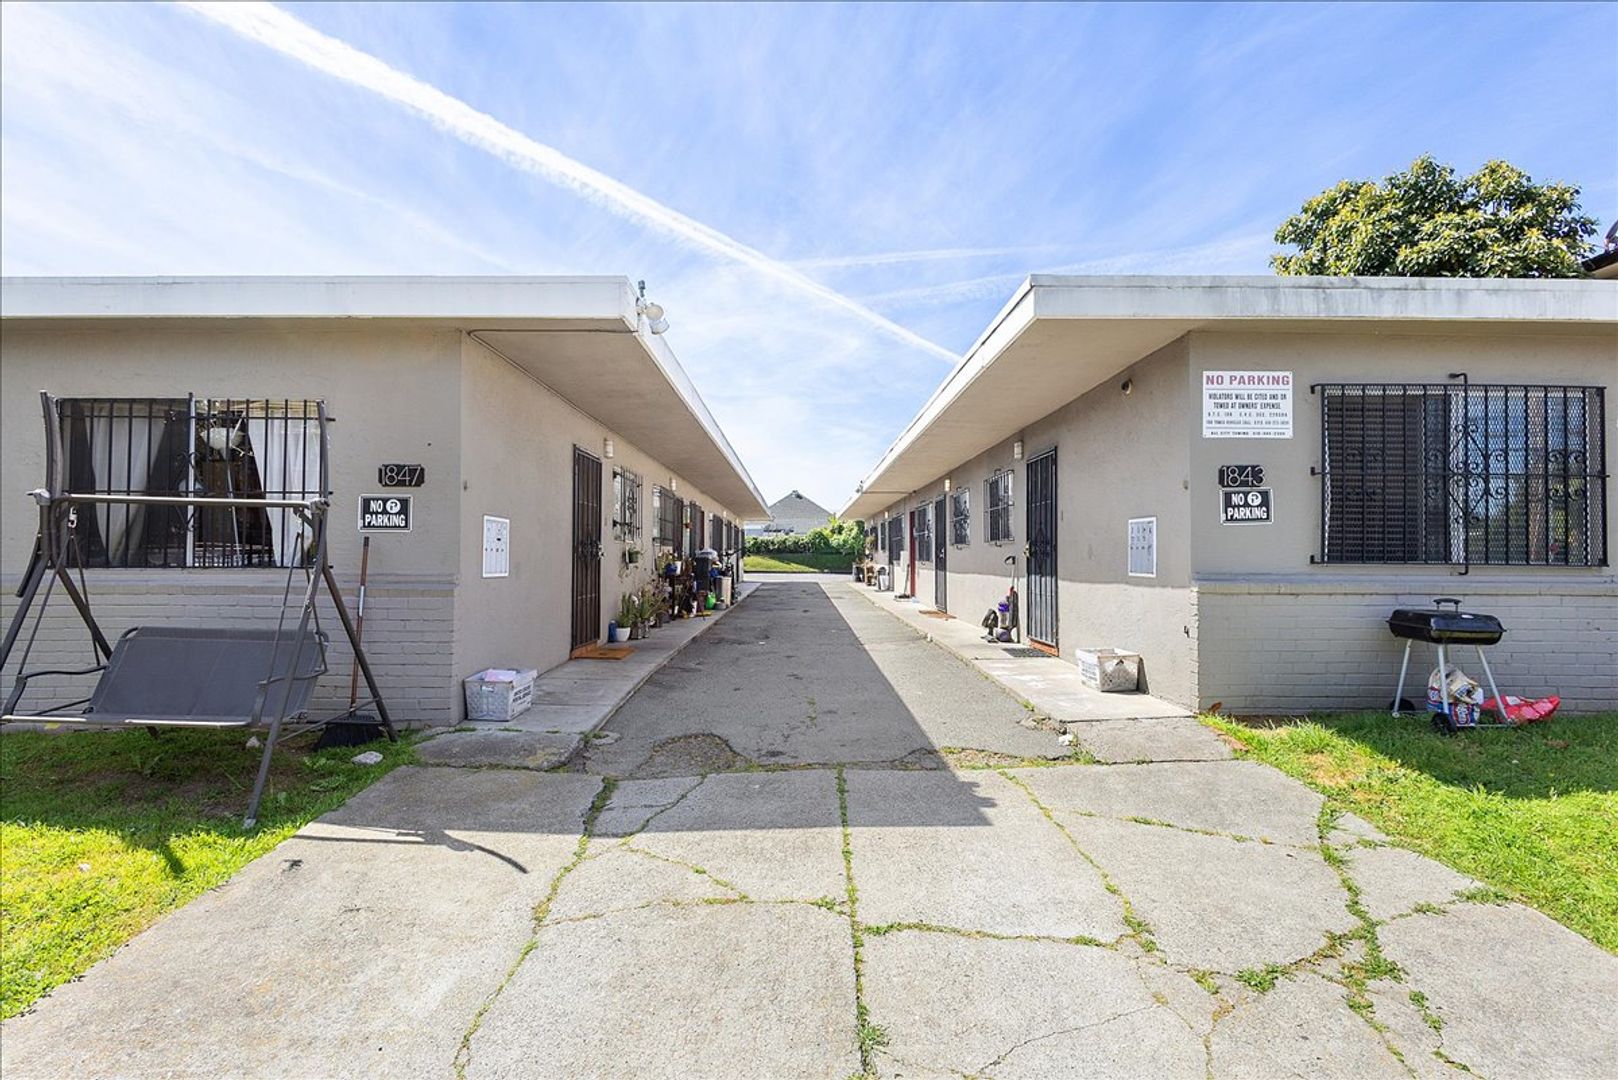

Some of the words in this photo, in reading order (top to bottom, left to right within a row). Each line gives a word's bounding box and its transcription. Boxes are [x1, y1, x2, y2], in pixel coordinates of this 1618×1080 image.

[1206, 375, 1224, 385] NO
[1229, 375, 1290, 385] PARKING
[382, 466, 421, 485] 1847
[1221, 466, 1265, 486] 1843
[370, 500, 383, 512] NO
[1231, 493, 1245, 506] NO
[1227, 506, 1268, 519] PARKING
[365, 514, 406, 526] PARKING
